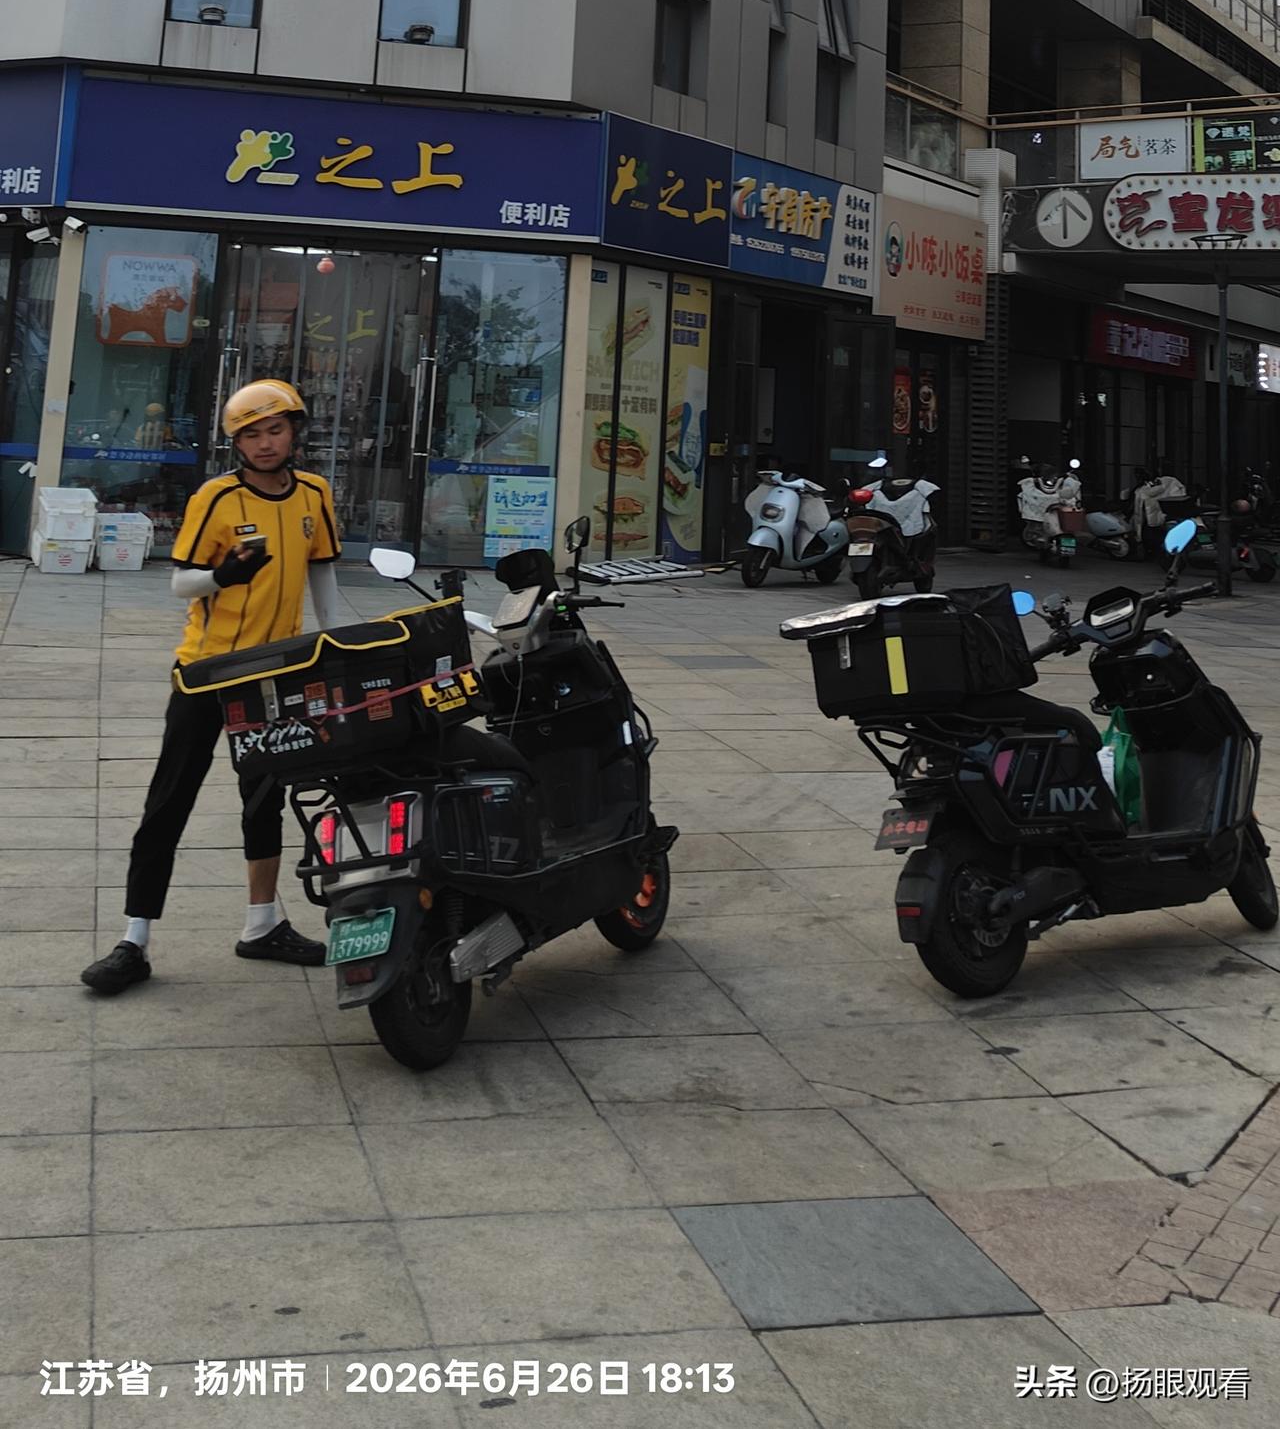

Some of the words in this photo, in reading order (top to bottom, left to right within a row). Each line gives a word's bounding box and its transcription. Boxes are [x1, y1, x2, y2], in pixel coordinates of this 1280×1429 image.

[0, 166, 42, 195] 利店
[315, 138, 463, 194] 之上
[656, 170, 728, 225] 之上
[499, 199, 571, 229] 便利店
[122, 259, 177, 272] NOWWA
